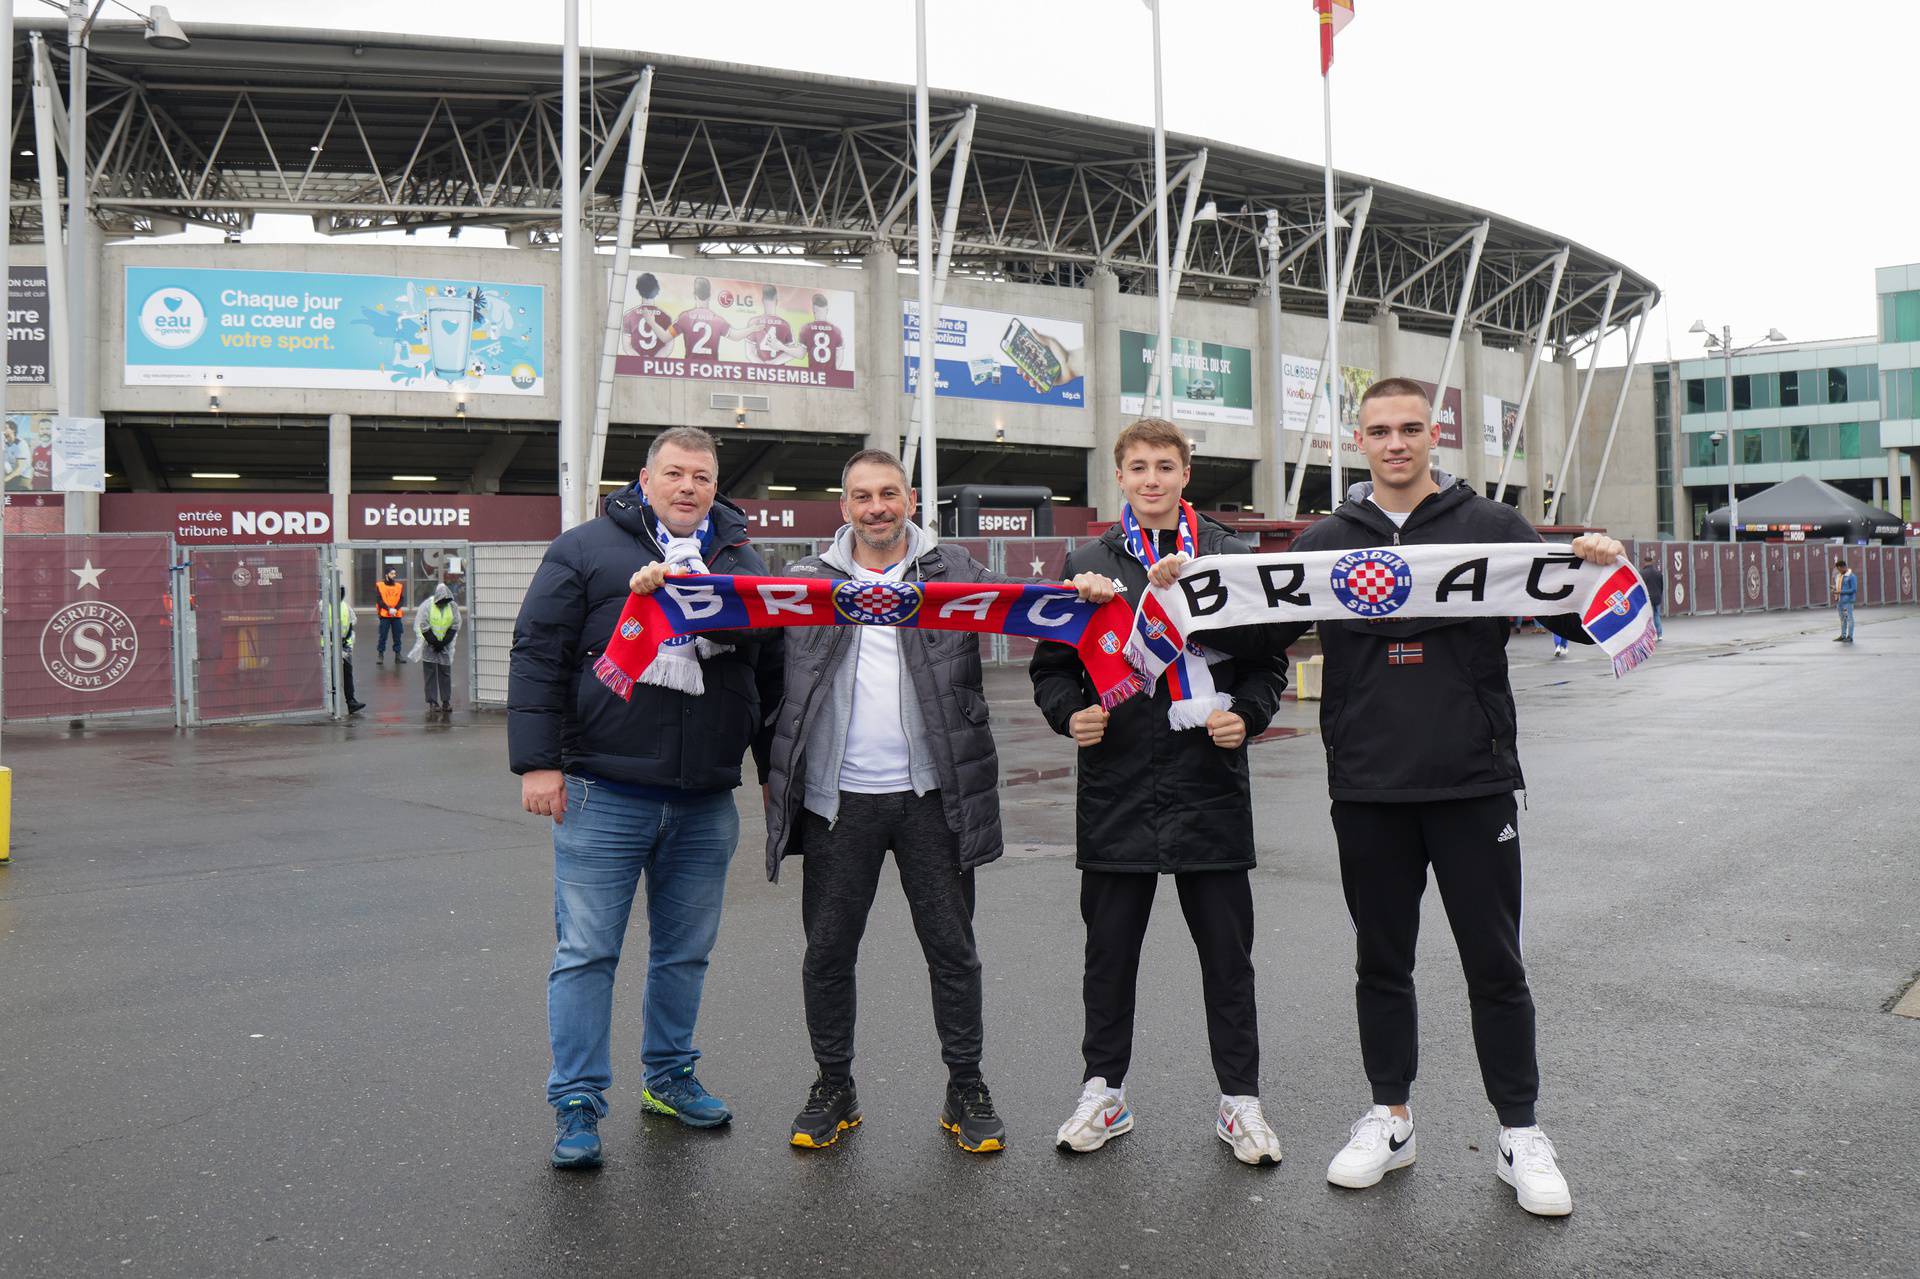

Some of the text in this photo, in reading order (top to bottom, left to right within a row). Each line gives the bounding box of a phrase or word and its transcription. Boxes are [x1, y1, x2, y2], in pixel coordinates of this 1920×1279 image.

[220, 290, 342, 313] Chaque jour
[736, 294, 753, 307] LG
[8, 310, 39, 323] are
[155, 315, 191, 327] eau
[220, 313, 335, 329] au cœur de
[7, 328, 45, 341] ems
[220, 332, 335, 351] votre sport.
[638, 318, 657, 350] 9
[692, 321, 712, 354] 2
[813, 332, 832, 363] 8
[14, 365, 28, 375] 37
[31, 365, 45, 375] 79
[643, 361, 826, 385] PLUS FORTS ENSEMBLE
[1341, 443, 1357, 452] ORD
[178, 510, 330, 536] entrée NORD
[364, 503, 470, 526] D'ÉQUIPE
[745, 509, 794, 527] -I-H
[978, 516, 1027, 531] ESPECT
[178, 525, 228, 537] tribune
[1335, 551, 1406, 573] HAJDUK
[1347, 599, 1399, 614] SPLIT
[849, 609, 902, 624] SPLIT
[52, 605, 135, 651] SERVETTE FC
[73, 622, 107, 669] S
[51, 656, 129, 687] GENEVE 1890
